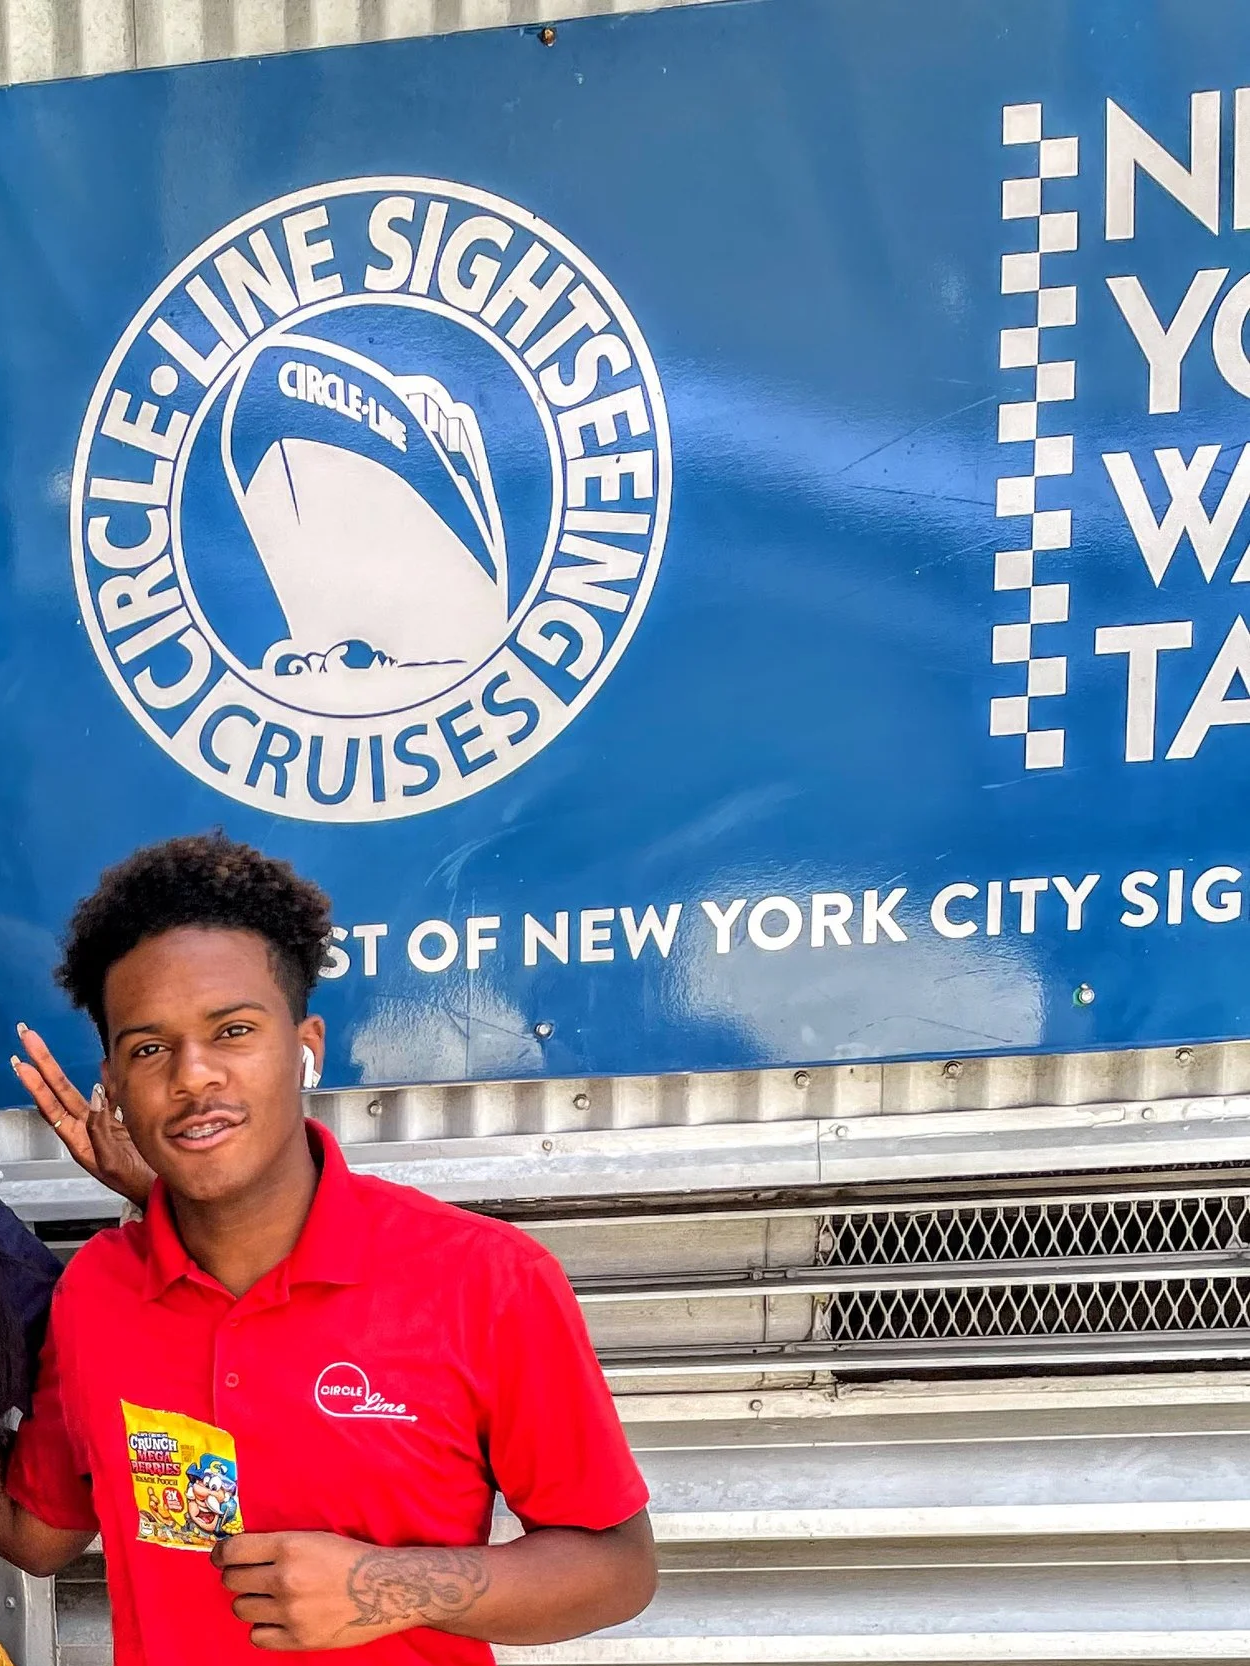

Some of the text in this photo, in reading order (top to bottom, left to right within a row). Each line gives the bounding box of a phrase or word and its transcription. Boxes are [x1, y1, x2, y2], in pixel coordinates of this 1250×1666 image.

[1105, 86, 1250, 240] N
[363, 196, 655, 685] SIGHTSEEING
[1101, 444, 1250, 588] W
[199, 672, 540, 806] CRUISES
[407, 916, 500, 974] OF
[525, 903, 682, 966] NEW
[701, 888, 908, 954] YORK
[931, 873, 1101, 940] CITY
[1119, 865, 1243, 928] SIG
[320, 1385, 364, 1397] CIRCLE
[352, 1392, 407, 1414] Line
[130, 1434, 179, 1452] CRUNCH
[131, 1461, 182, 1477] BERRIES
[137, 1450, 172, 1462] MEGA
